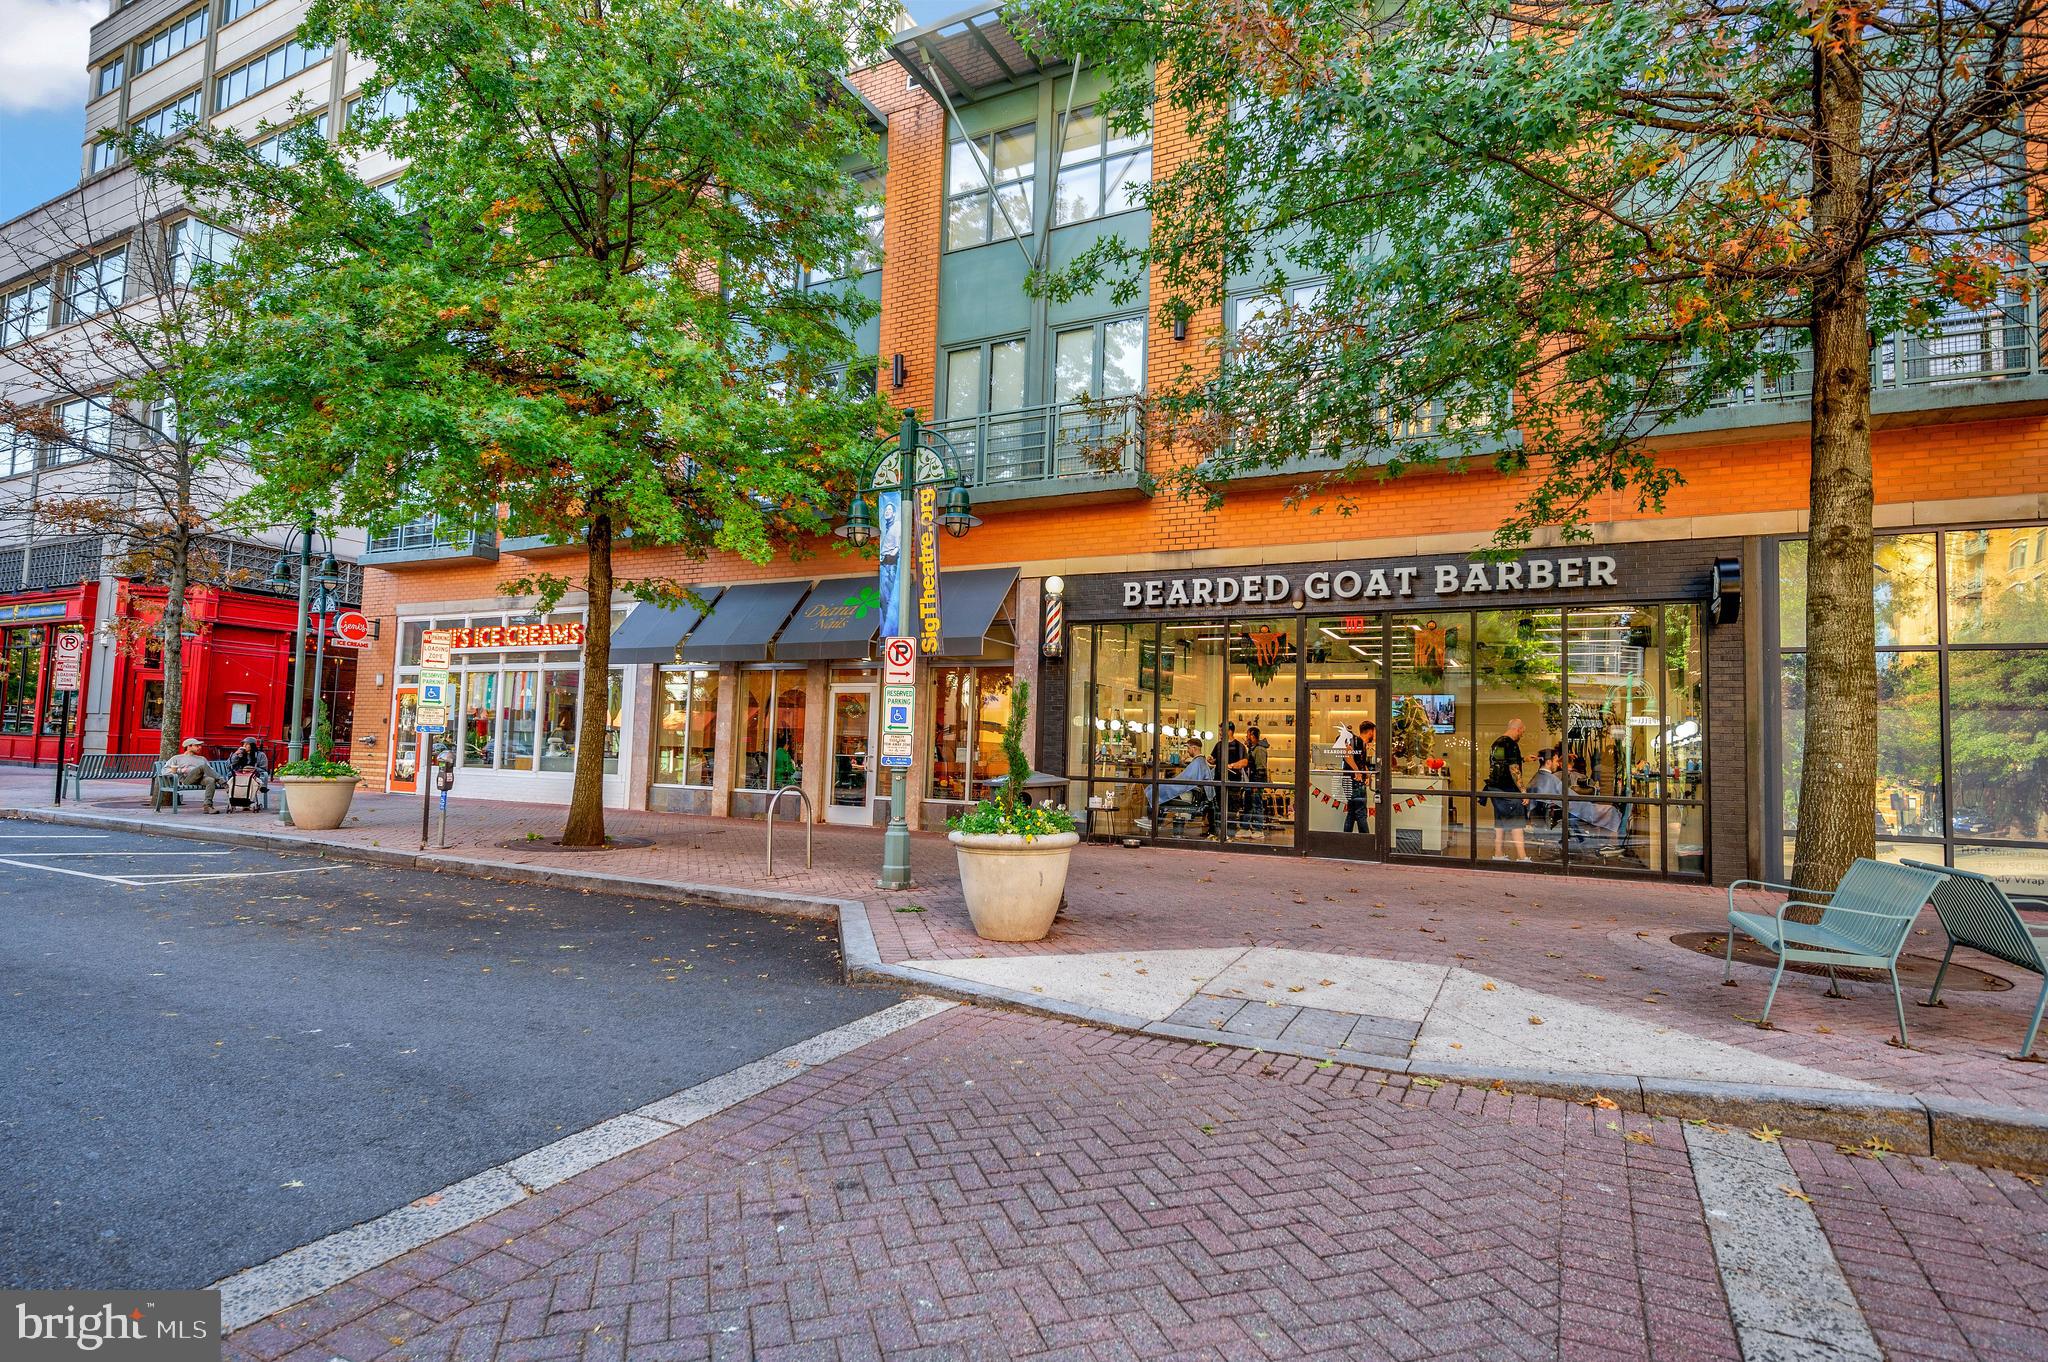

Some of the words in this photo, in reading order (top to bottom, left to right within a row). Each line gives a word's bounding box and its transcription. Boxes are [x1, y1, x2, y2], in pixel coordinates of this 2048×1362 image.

[918, 488, 940, 654] SigTheatre.org
[1123, 574, 1291, 607] BEARDED
[1304, 566, 1417, 601] GOAT
[1434, 555, 1618, 594] BARBER
[804, 602, 858, 618] Diana
[809, 617, 848, 631] Nails
[474, 626, 504, 648] ICE
[506, 623, 583, 647] CREAMS
[424, 645, 448, 653] LOADING
[429, 652, 443, 660] ZONE
[887, 689, 912, 697] RESERVED
[887, 697, 911, 706] PARKING
[1961, 846, 1981, 855] Hot
[1984, 847, 2015, 857] Stone
[2014, 875, 2045, 886] Wrap
